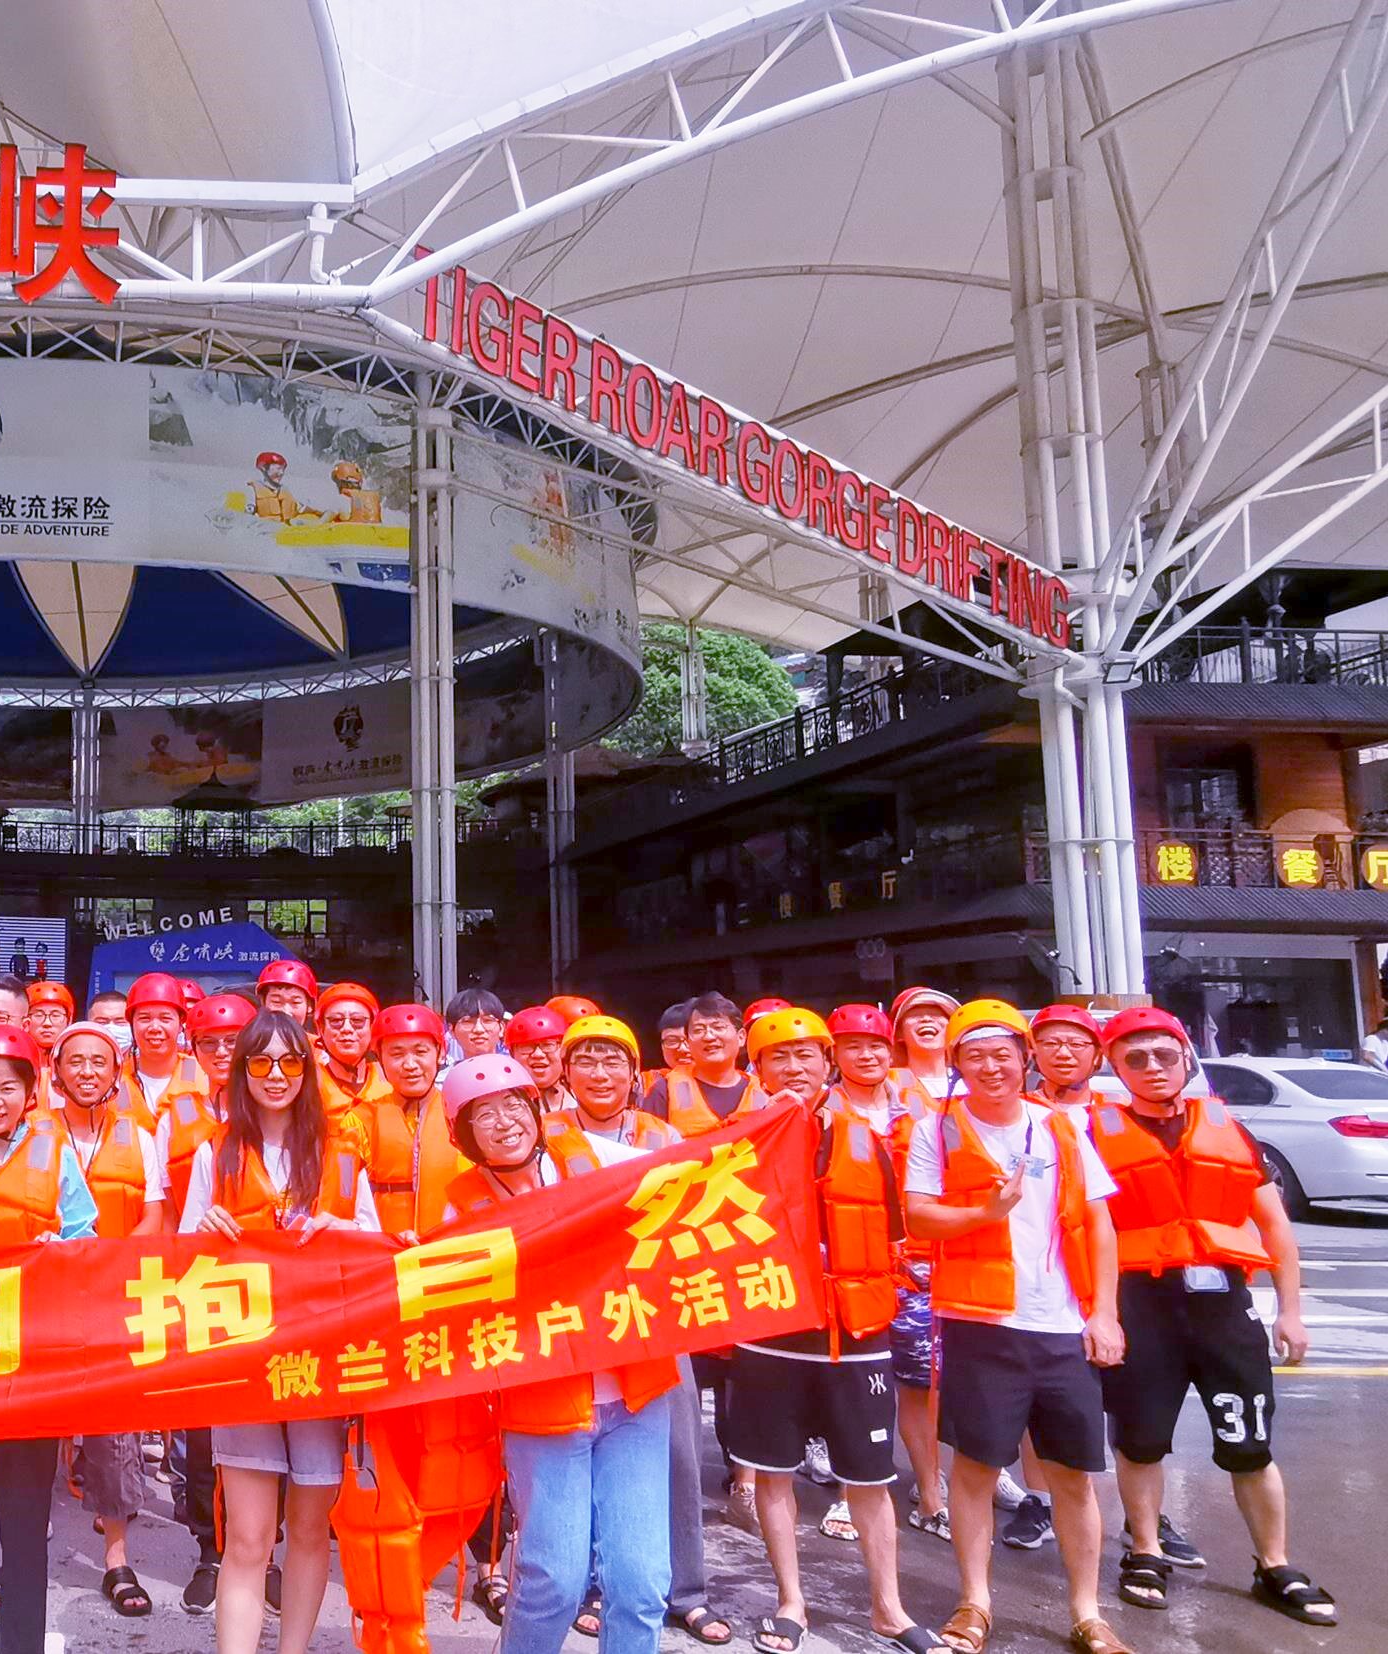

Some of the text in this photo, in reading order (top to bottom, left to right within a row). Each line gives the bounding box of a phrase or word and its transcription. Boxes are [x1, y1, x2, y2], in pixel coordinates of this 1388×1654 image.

[415, 244, 1069, 649] TIGER ROAR GORGE DRIFTING
[24, 525, 110, 537] ADVENTURE
[103, 906, 234, 942] WELCOME
[1213, 1393, 1267, 1443] 31
